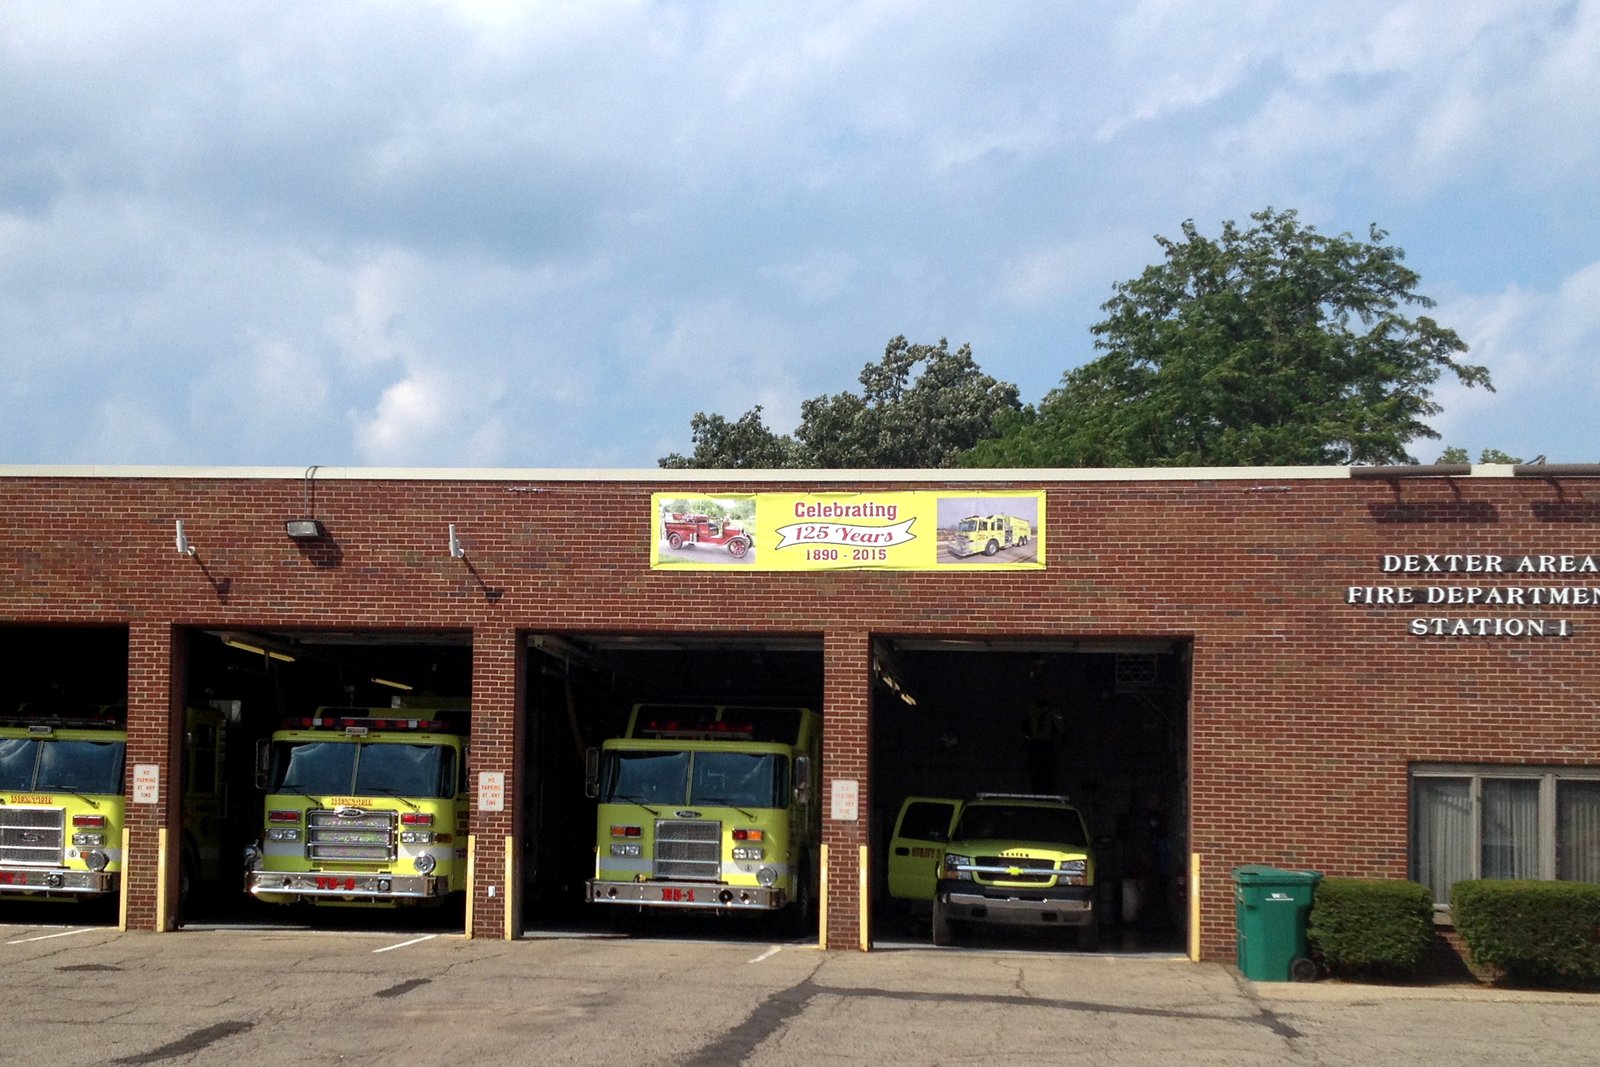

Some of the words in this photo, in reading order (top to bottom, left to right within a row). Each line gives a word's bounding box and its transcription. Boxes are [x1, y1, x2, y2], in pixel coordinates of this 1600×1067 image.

[795, 502, 897, 520] Celebrating
[795, 526, 829, 541] 125
[835, 527, 893, 543] Years
[806, 549, 838, 560] 1890
[852, 549, 887, 560] 2015
[1384, 555, 1503, 572] DEXTER
[1516, 555, 1599, 572] AREA
[1348, 586, 1415, 604] FIRE
